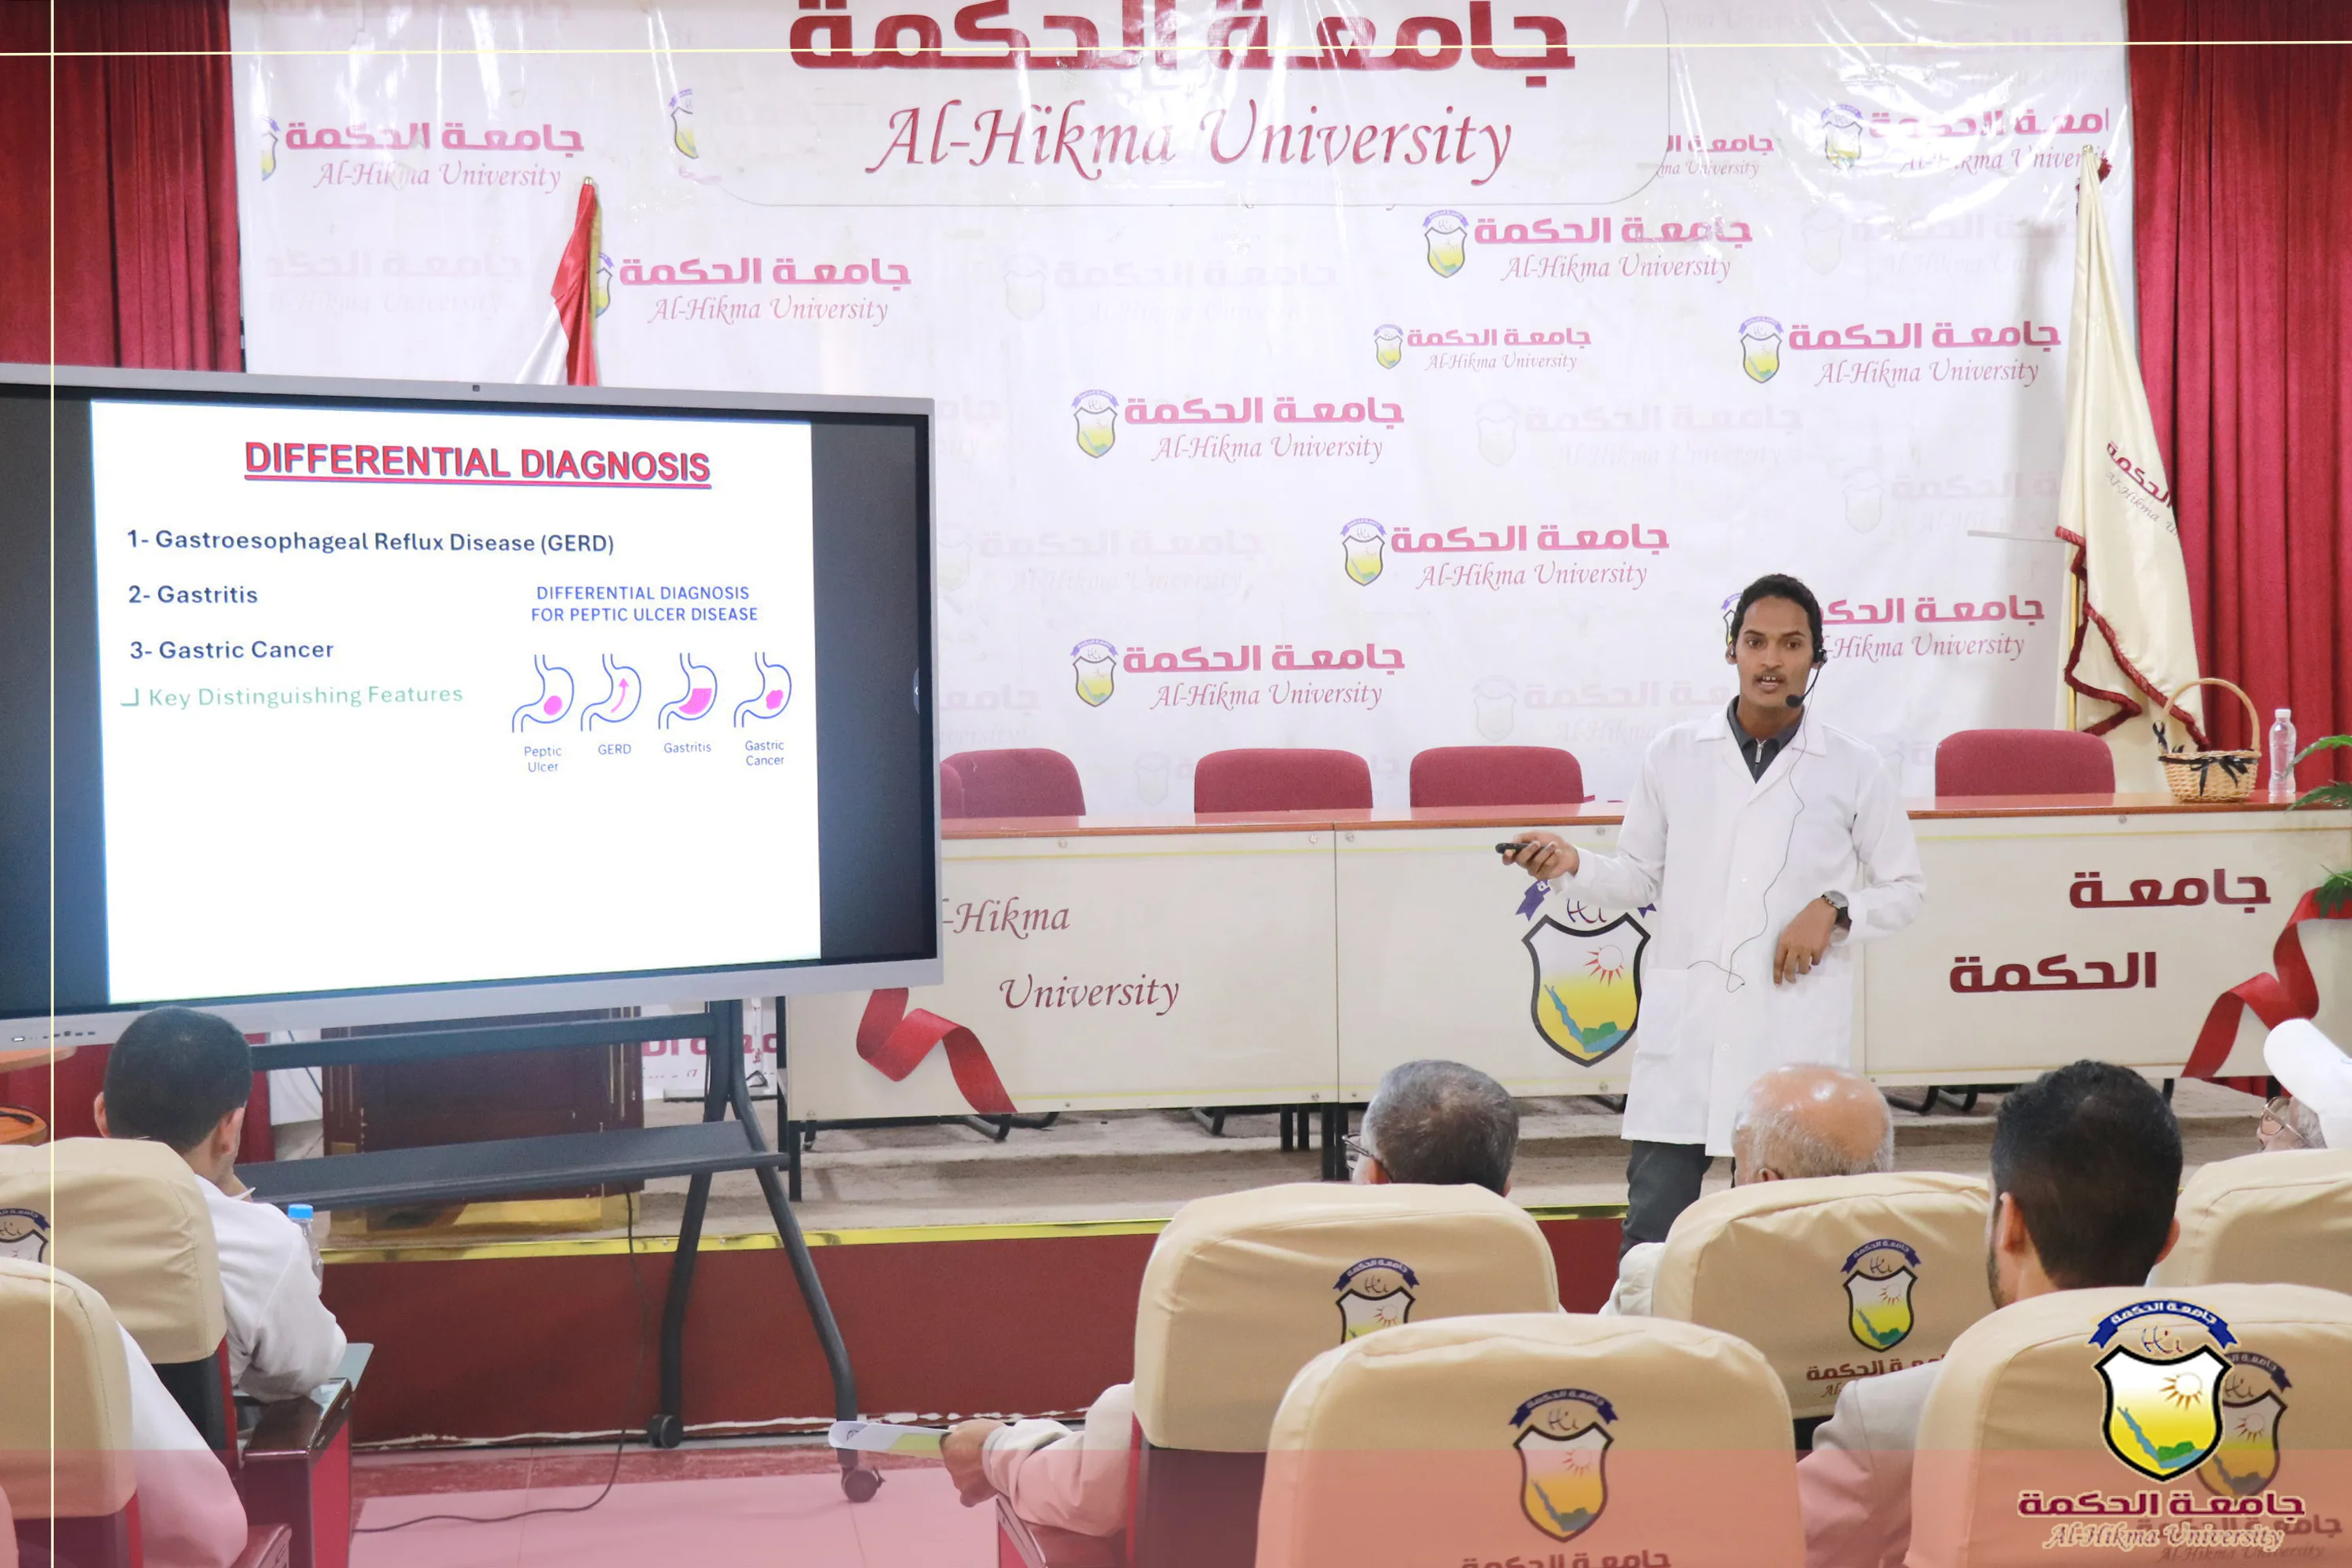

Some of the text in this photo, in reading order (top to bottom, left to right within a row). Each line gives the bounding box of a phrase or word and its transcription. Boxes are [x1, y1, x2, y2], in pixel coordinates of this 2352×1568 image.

[285, 121, 584, 158] جامعة الحكمة
[863, 93, 1514, 188] Al-Hikma University
[313, 160, 560, 194] Al-Hikma University
[1475, 217, 1611, 244] الحكمة
[1622, 217, 1752, 248] جامعة
[620, 258, 912, 291] جامعة الحكمة
[1501, 253, 1730, 284] Al-Hikma University
[647, 295, 888, 326] Al-Hikma University
[1408, 329, 1497, 346] الحكمة
[1504, 328, 1591, 349] جامعة
[1789, 322, 1922, 350] الحكمة
[1932, 320, 2061, 352] جامعة
[1428, 352, 1577, 372] Al-Hikma University
[1815, 360, 2039, 388] Al-Hikma University
[1125, 398, 1263, 424] الحكمة
[1274, 397, 1404, 429] جامعة
[244, 441, 712, 483] DIFFERENTIAL DIAGNOSIS
[1152, 433, 1382, 464] Al-Hikma University
[128, 530, 613, 556] 1- Gastroesophageal Reflux Disease (GERD)
[1391, 526, 1527, 553] الحكمة
[1537, 523, 1669, 555] جامعة
[1415, 560, 1646, 591] Al-Hikma University
[129, 586, 258, 603] 2- Gastritis
[537, 586, 748, 600] DIFFERENTIAL DIAGNOSIS
[532, 608, 757, 621] FOR PEPTIC ULCER DISEASE
[1914, 594, 2045, 627] جامعة
[130, 641, 334, 659] 3- Gastric Cancer
[1123, 645, 1261, 673] الحكمة
[1272, 643, 1405, 675] جامعة
[1911, 632, 2025, 662] University
[150, 686, 462, 710] Key Distinguishing Features
[1150, 680, 1381, 711] Al-Hikma University
[525, 747, 561, 757] Peptic
[598, 744, 631, 755] GERD
[665, 743, 711, 752] Gastritis
[745, 741, 783, 751] Gastric
[529, 762, 558, 772] Ulcer
[746, 756, 784, 766] Cancer
[2069, 869, 2271, 914] جامعة
[941, 895, 1071, 940] -Hikma
[1950, 952, 2157, 993] الحكمة
[1000, 974, 1179, 1016] University
[1806, 1359, 1885, 1381] الحكمة
